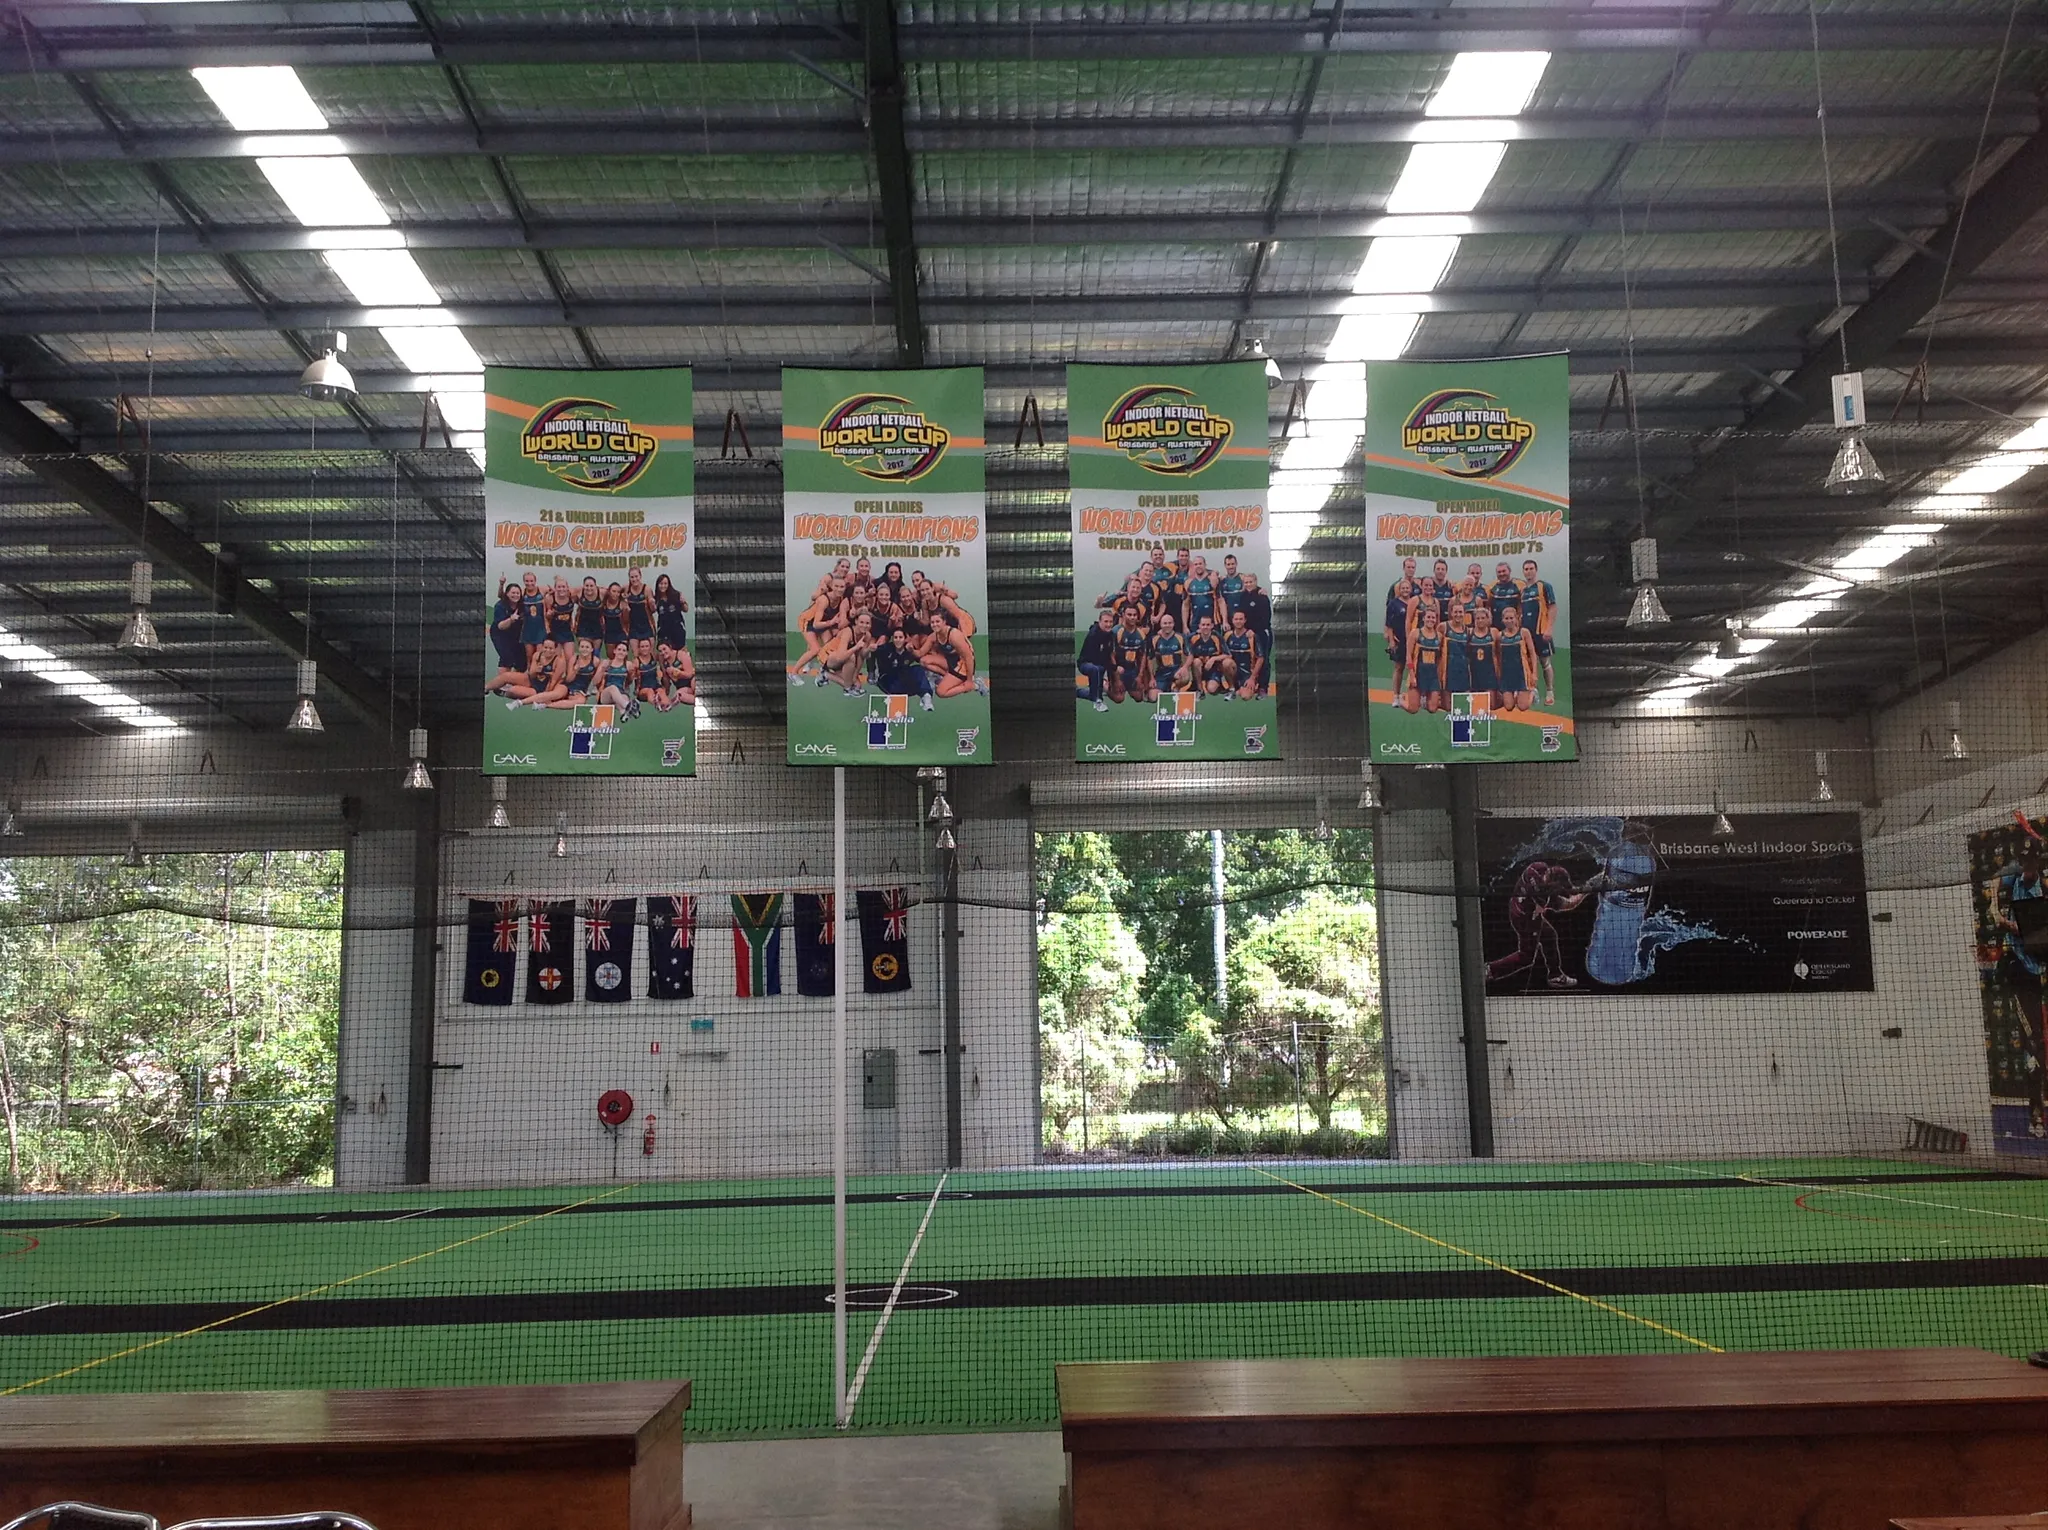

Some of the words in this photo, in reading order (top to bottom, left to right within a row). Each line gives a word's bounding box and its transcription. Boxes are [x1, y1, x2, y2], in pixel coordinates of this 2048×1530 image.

[1125, 407, 1163, 421] INDOOR
[1164, 406, 1205, 420] NETBALL
[1425, 411, 1463, 426] INDOOR
[1464, 410, 1505, 423] NETBALL
[545, 420, 584, 433] INDOOR
[586, 420, 628, 434] NETBALL
[841, 414, 880, 428] INDOOR
[881, 414, 922, 428] NETBALL
[1106, 420, 1180, 440] WORLD
[1186, 420, 1229, 439] CUP
[1406, 425, 1480, 445] WORLD
[1487, 424, 1530, 442] CUP
[525, 434, 602, 452] WORLD
[609, 435, 653, 454] CUP
[822, 428, 897, 446] WORLD
[904, 429, 947, 447] CUP
[1118, 440, 1157, 448] BRISBANE
[1167, 440, 1212, 448] AUSTRALIA
[835, 447, 875, 455] BRISBANE
[884, 447, 930, 455] AUSTRALIA
[1418, 444, 1457, 453] BRISBANE
[1467, 443, 1513, 453] AUSTRALIA
[538, 454, 579, 462] BRISBANE
[886, 460, 905, 470] 2012
[1169, 454, 1187, 464] 2012
[1469, 457, 1487, 469] 2012
[592, 469, 611, 479] 2012
[854, 500, 884, 514] OPEN
[885, 500, 923, 514] LADIES
[1138, 494, 1167, 507] OPEN
[1168, 494, 1200, 507] MENS
[1436, 500, 1464, 514] OPEN
[1465, 499, 1500, 512] MIXED
[539, 509, 554, 522] 21
[555, 511, 564, 522] &
[566, 511, 604, 524] UNDER
[606, 511, 645, 524] LADIES
[1079, 507, 1146, 535] WORLD
[1147, 505, 1263, 536] CHAMPIONS
[793, 513, 863, 541] WORLD
[864, 515, 980, 543] CHAMPIONS
[1376, 513, 1444, 541] WORLD
[1444, 509, 1563, 542] CHAMPIONS
[494, 521, 567, 550] WORLD
[568, 522, 687, 553] CHAMPIONS
[1099, 536, 1134, 550] SUPER
[1153, 540, 1161, 549] &
[1163, 537, 1203, 551] WORLD
[1204, 536, 1228, 549] CUP
[813, 543, 851, 556] SUPER
[870, 546, 880, 557] &
[880, 545, 920, 558] WORLD
[921, 545, 943, 558] CUP
[1395, 544, 1430, 558] SUPER
[1450, 547, 1459, 557] &
[1459, 544, 1500, 557] WORLD
[1502, 542, 1525, 556] CUP
[515, 552, 553, 567] SUPER
[575, 557, 584, 568] &
[585, 555, 627, 569] WORLD
[628, 555, 652, 568] CUP
[861, 715, 915, 724] Australia
[1150, 712, 1202, 721] Australia
[1444, 712, 1497, 721] Australia
[564, 724, 621, 734] Australia
[1660, 842, 1720, 855] Brisbane
[1724, 841, 1757, 854] West
[1762, 841, 1808, 853] Indoor
[1811, 840, 1853, 853] Sports
[1787, 930, 1849, 940] POWERADE
